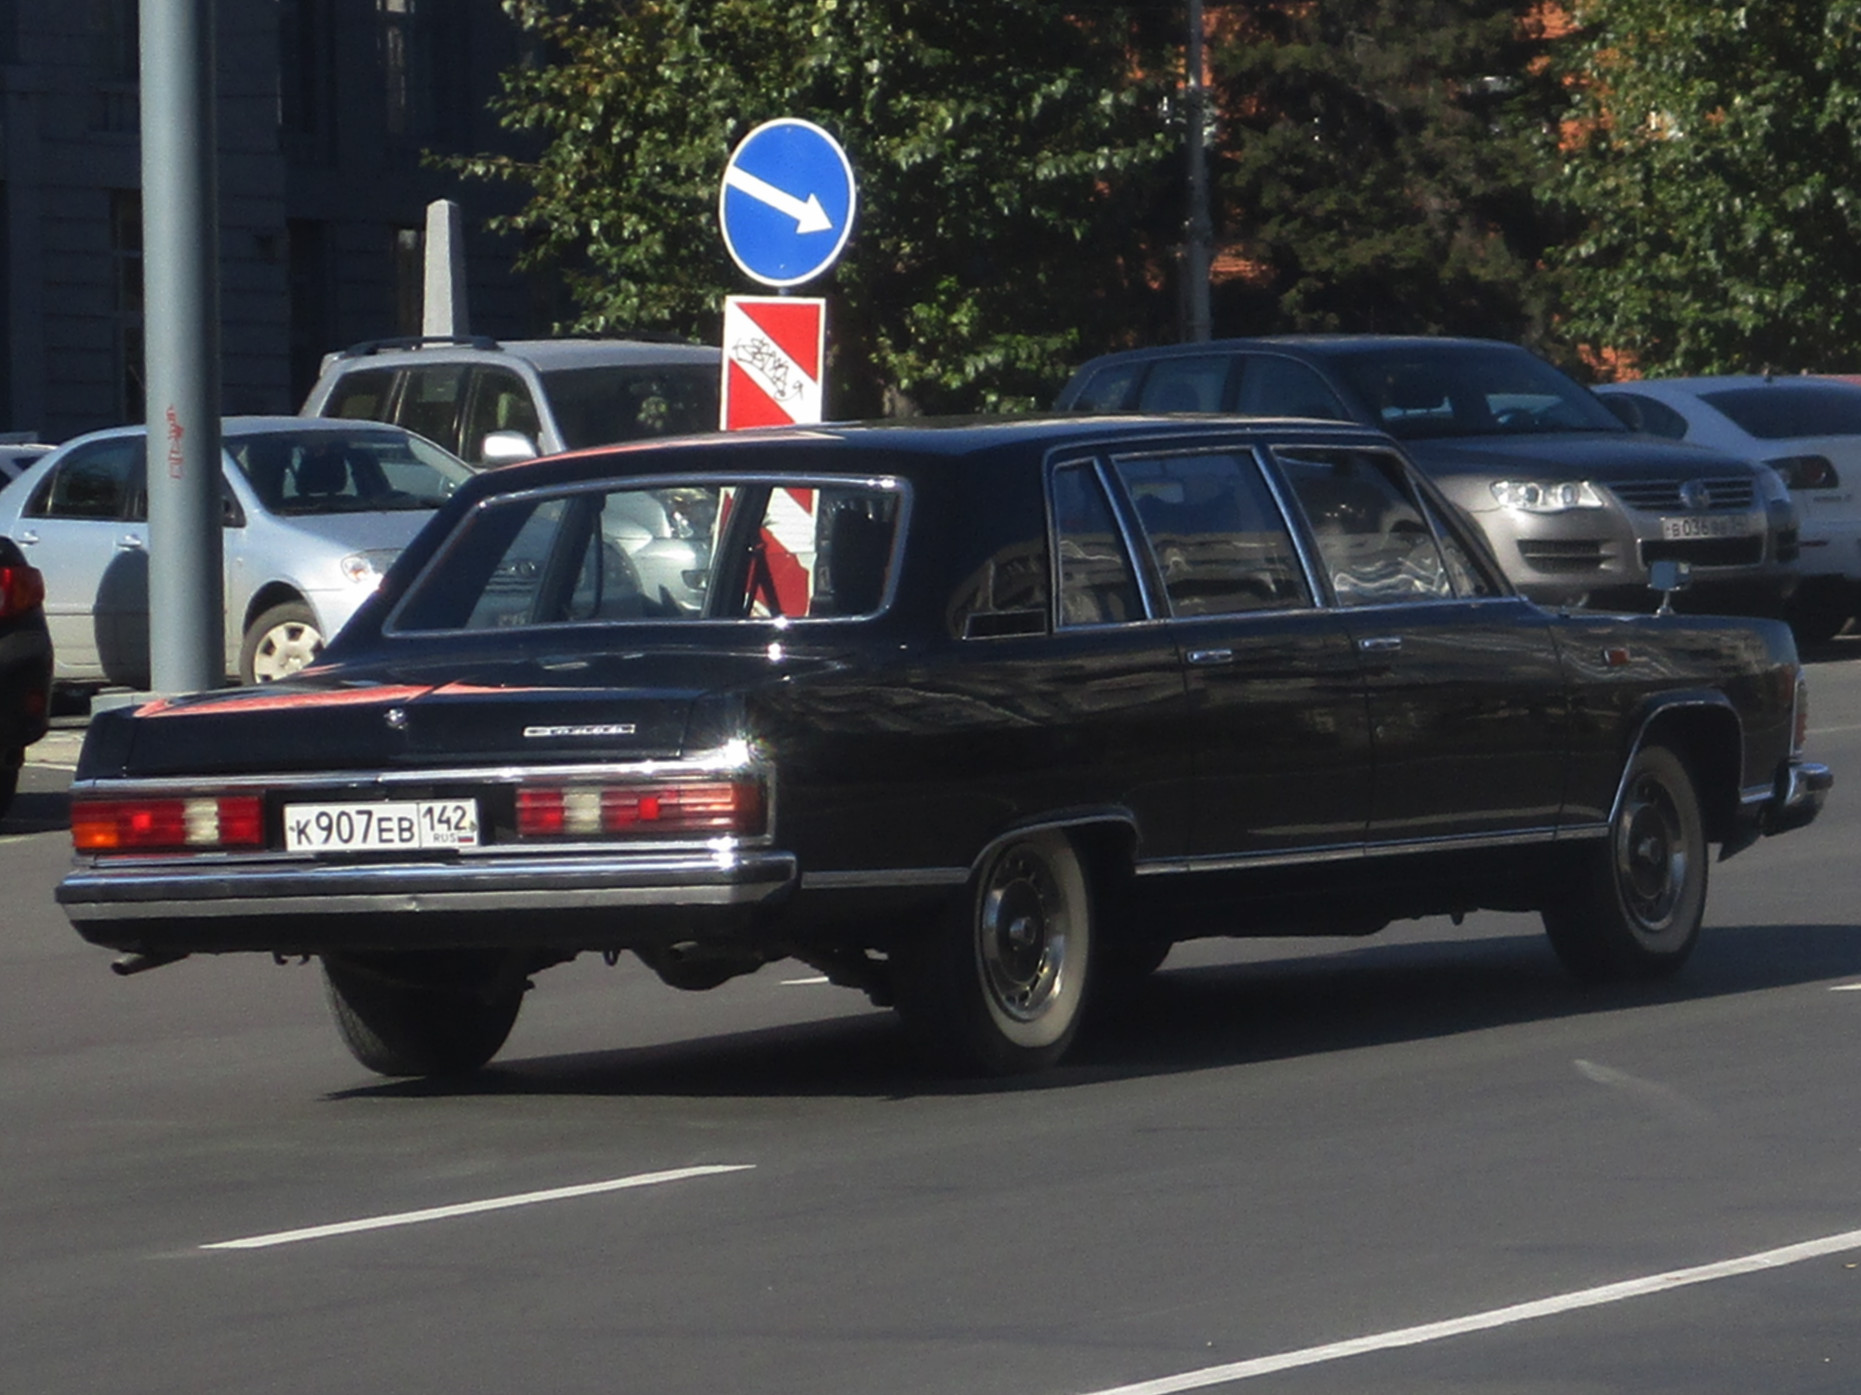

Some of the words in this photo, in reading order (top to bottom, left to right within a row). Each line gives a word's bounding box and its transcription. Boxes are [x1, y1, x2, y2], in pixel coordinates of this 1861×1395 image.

[295, 809, 415, 845] K907EB
[422, 805, 467, 832] 142
[433, 832, 457, 843] RUS
